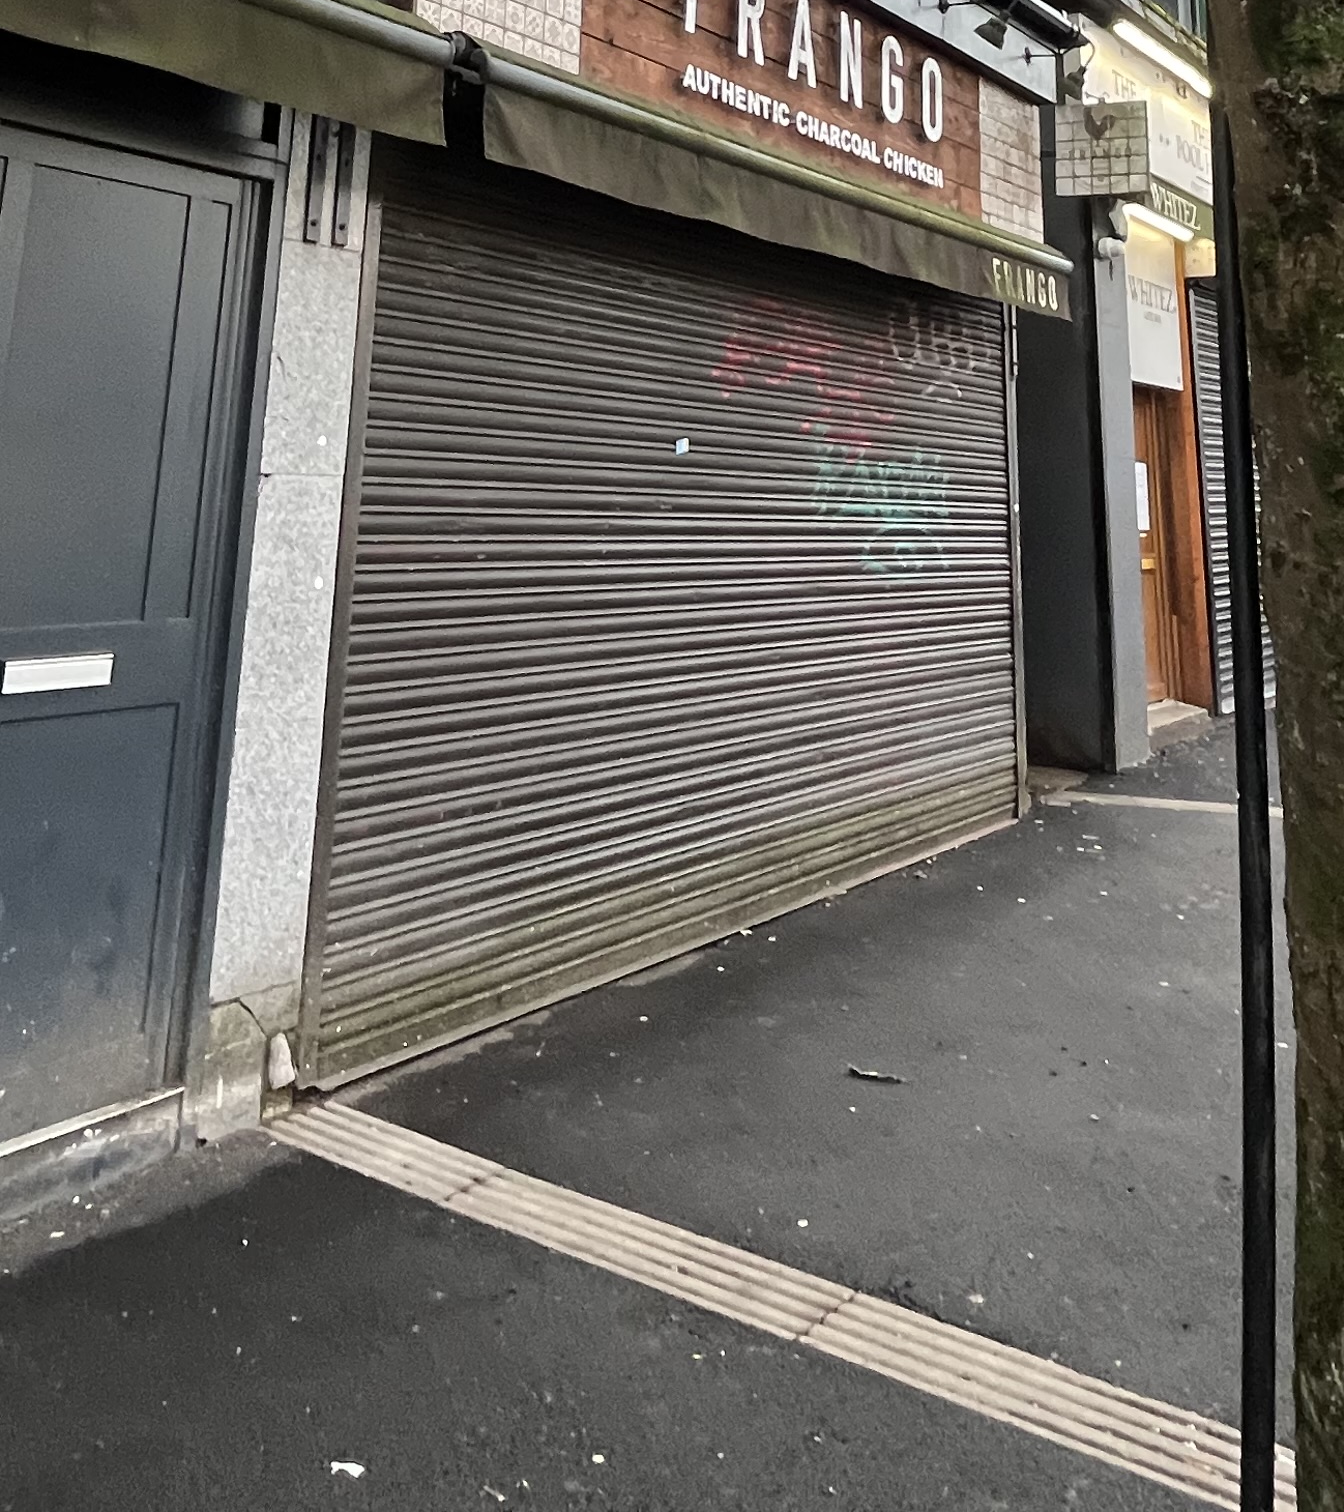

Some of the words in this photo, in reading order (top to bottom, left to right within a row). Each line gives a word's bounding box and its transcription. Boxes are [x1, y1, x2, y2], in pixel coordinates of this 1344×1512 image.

[682, 63, 791, 127] AUTHENTIC
[795, 110, 881, 164] CHARCOAL
[883, 146, 944, 189] CHICKEN
[1150, 182, 1201, 231] WHITEZ
[991, 257, 1059, 312] FRANGO
[1127, 274, 1177, 314] WHITEZ
